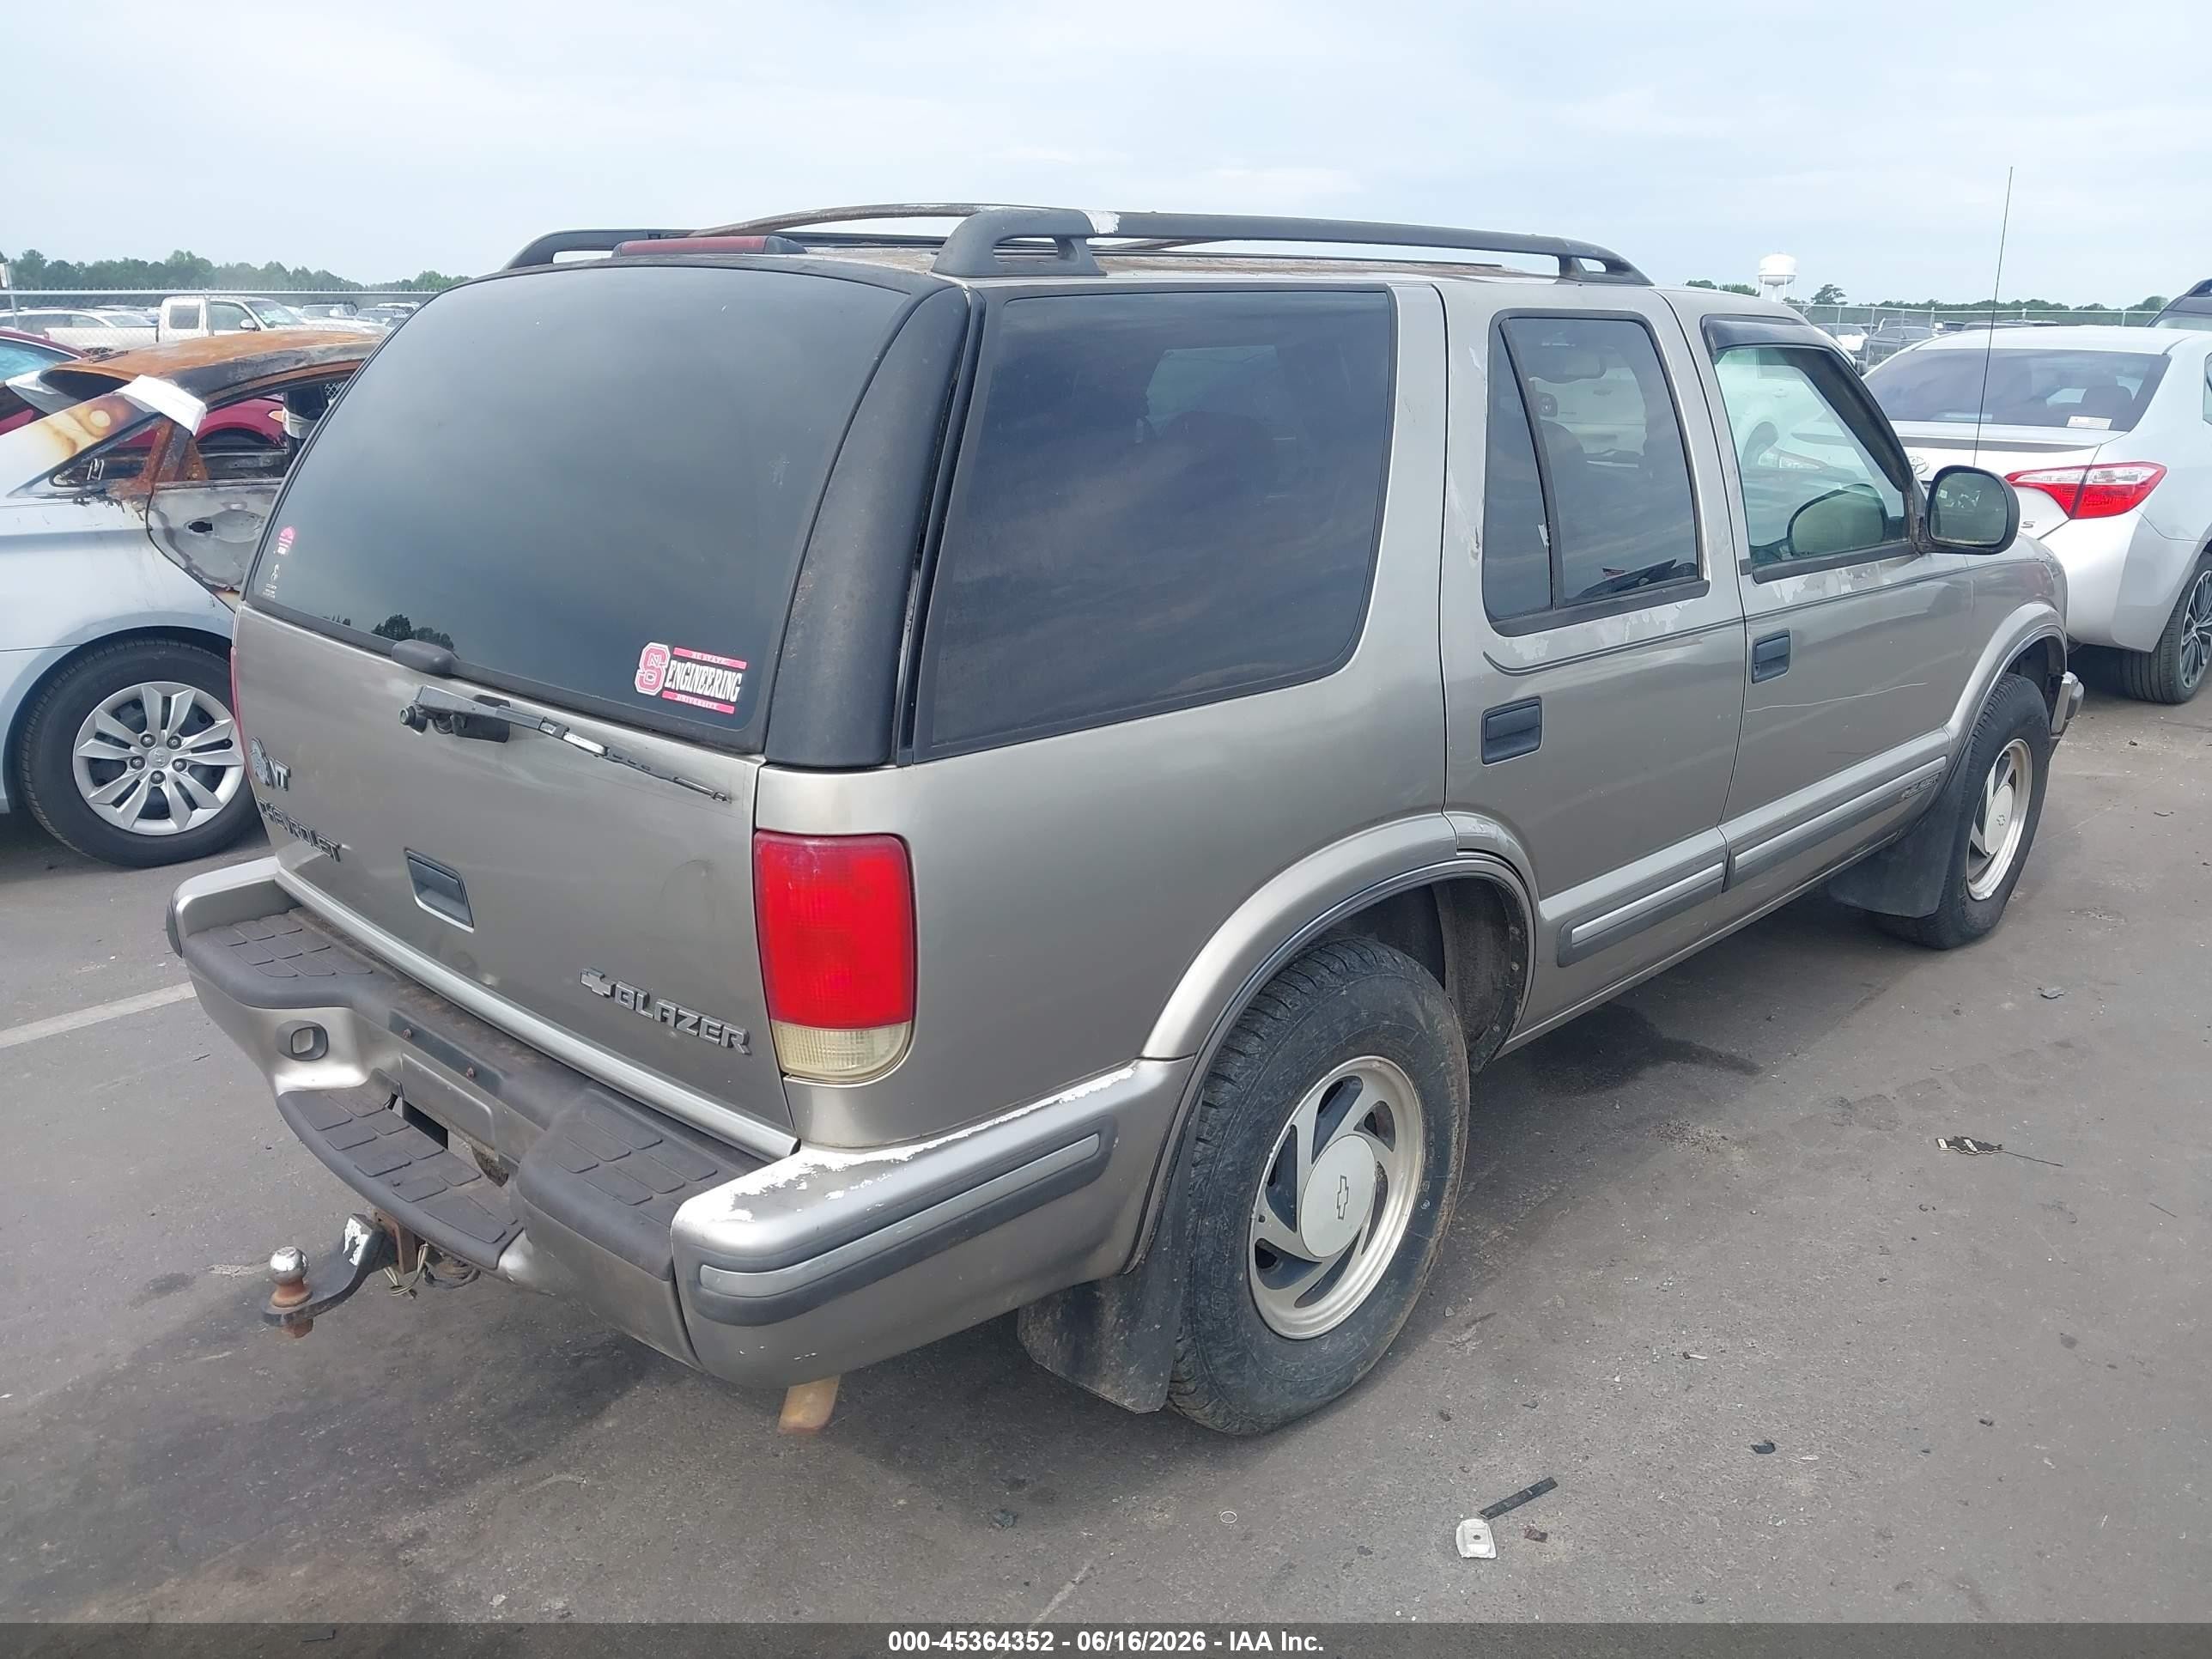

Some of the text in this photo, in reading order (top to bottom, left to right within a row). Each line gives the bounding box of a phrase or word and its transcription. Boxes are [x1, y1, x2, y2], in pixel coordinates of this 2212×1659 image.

[2020, 520, 2036, 529] S
[665, 659, 743, 702] ENGINEERING
[614, 981, 752, 1056] BLAZER
